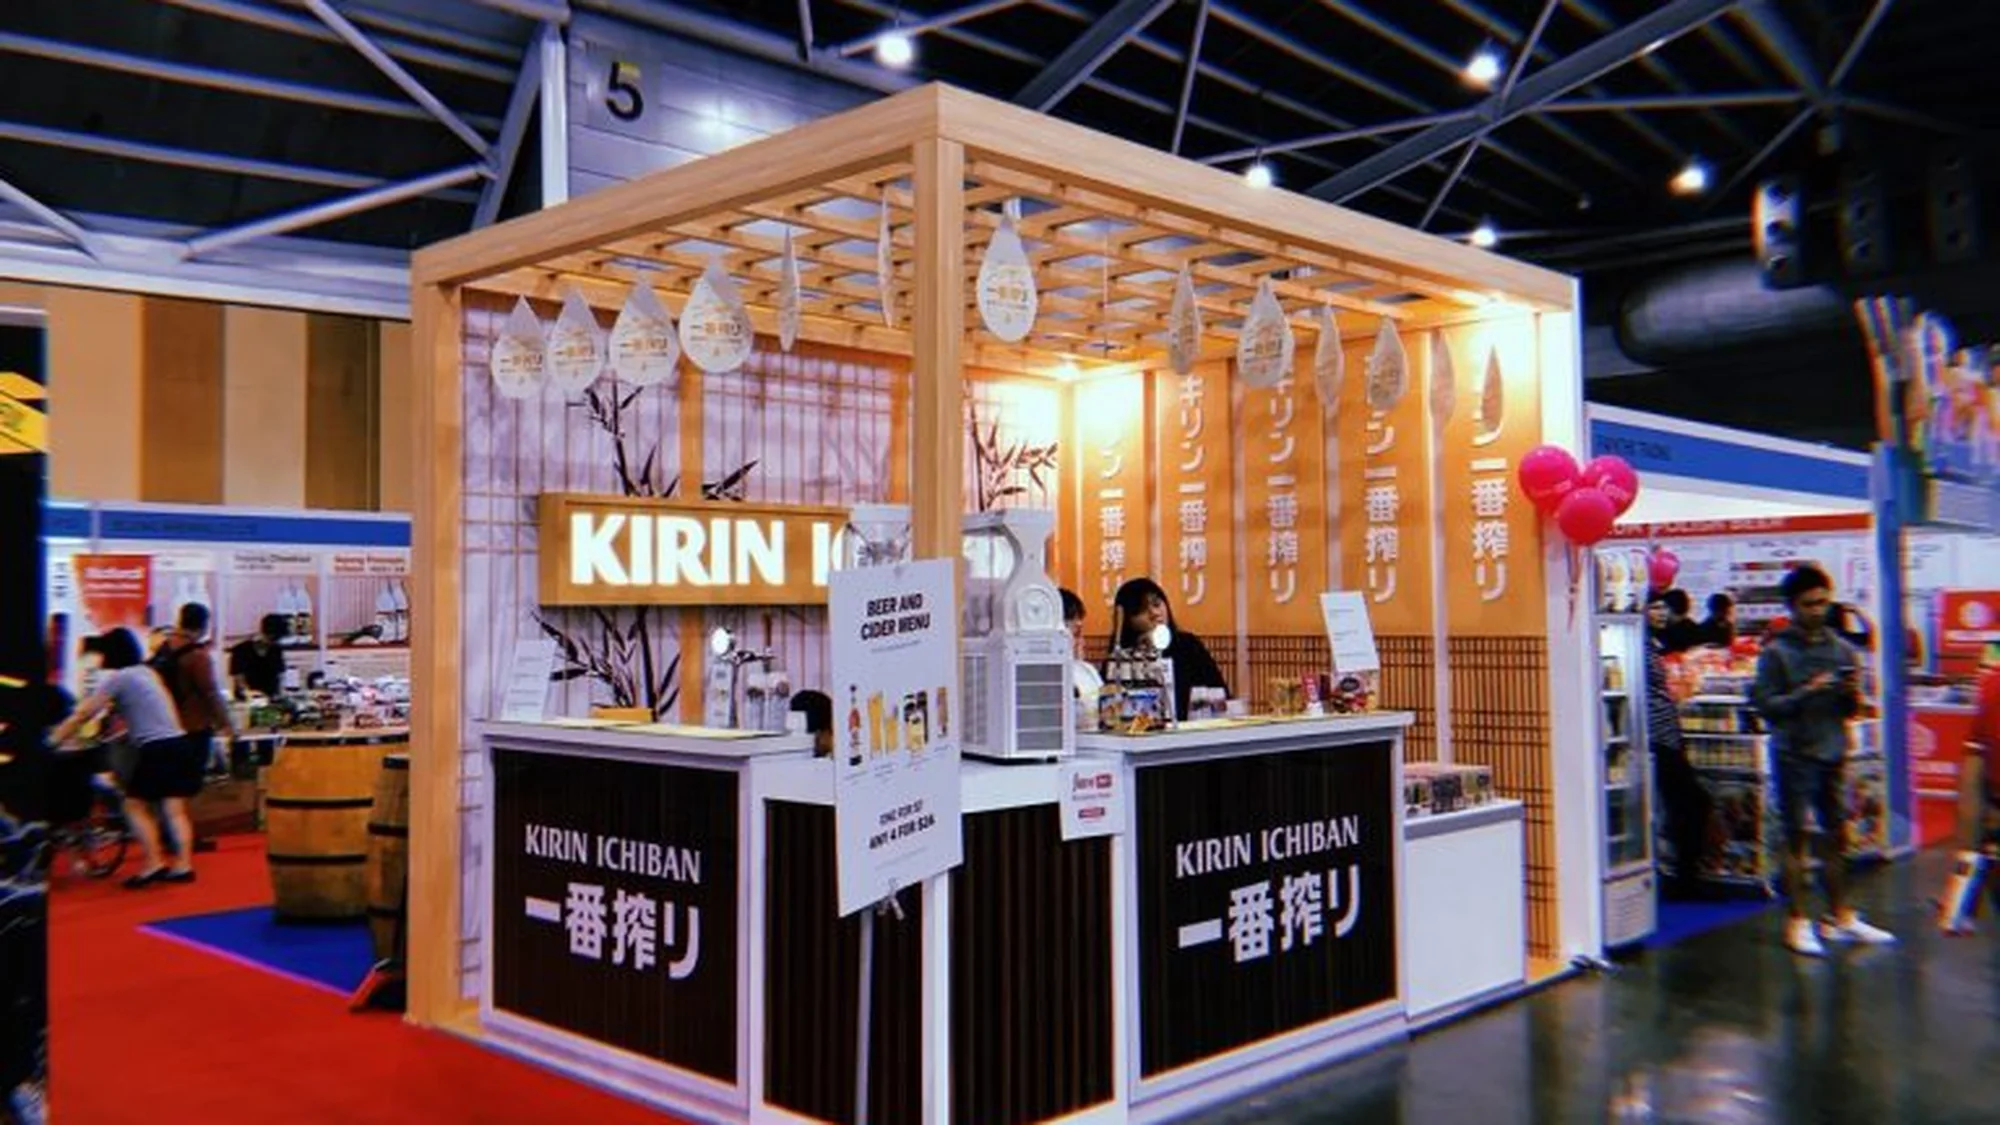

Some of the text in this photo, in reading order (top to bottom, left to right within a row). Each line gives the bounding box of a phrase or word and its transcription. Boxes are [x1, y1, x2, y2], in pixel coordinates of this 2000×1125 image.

[605, 62, 643, 122] 5
[569, 512, 787, 587] KIRIN
[860, 612, 931, 641] CIDER MENU
[866, 592, 924, 618] BEER AND
[524, 823, 702, 885] KIRIN ICHIBAN
[898, 819, 915, 838] FOR
[1175, 814, 1360, 879] KIRIN ICHIBAN
[524, 881, 701, 981] 一番搾り
[1177, 863, 1361, 964] 一番搾り
